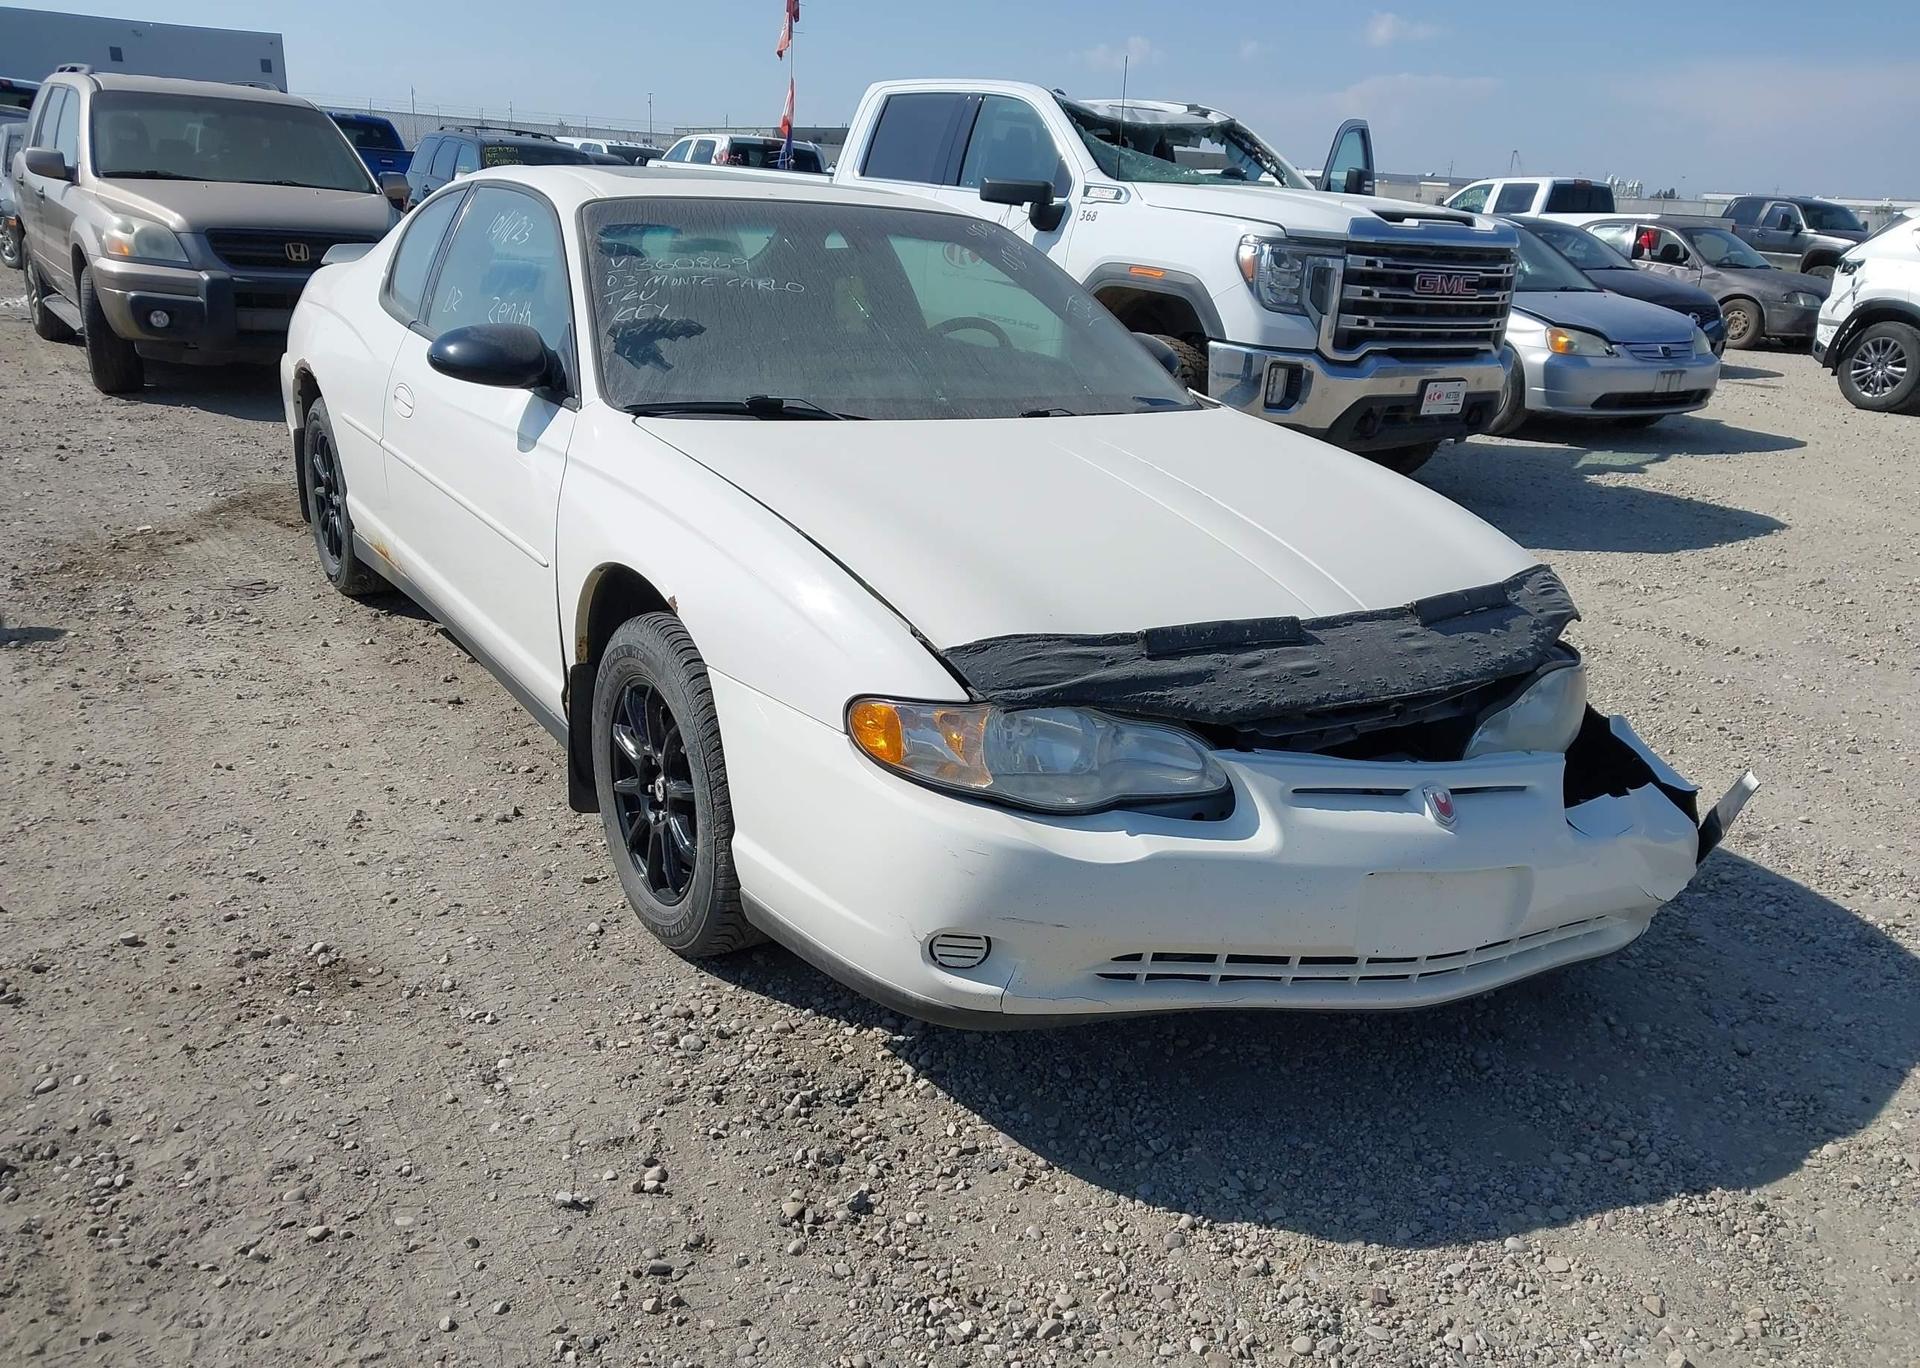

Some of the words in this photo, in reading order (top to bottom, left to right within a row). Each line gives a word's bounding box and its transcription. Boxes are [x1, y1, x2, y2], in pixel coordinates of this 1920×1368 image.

[1080, 210, 1098, 222] 368
[645, 274, 719, 288] MONTE
[726, 278, 806, 294] CARLO
[1415, 273, 1479, 295] GMC
[611, 303, 670, 322] KEY
